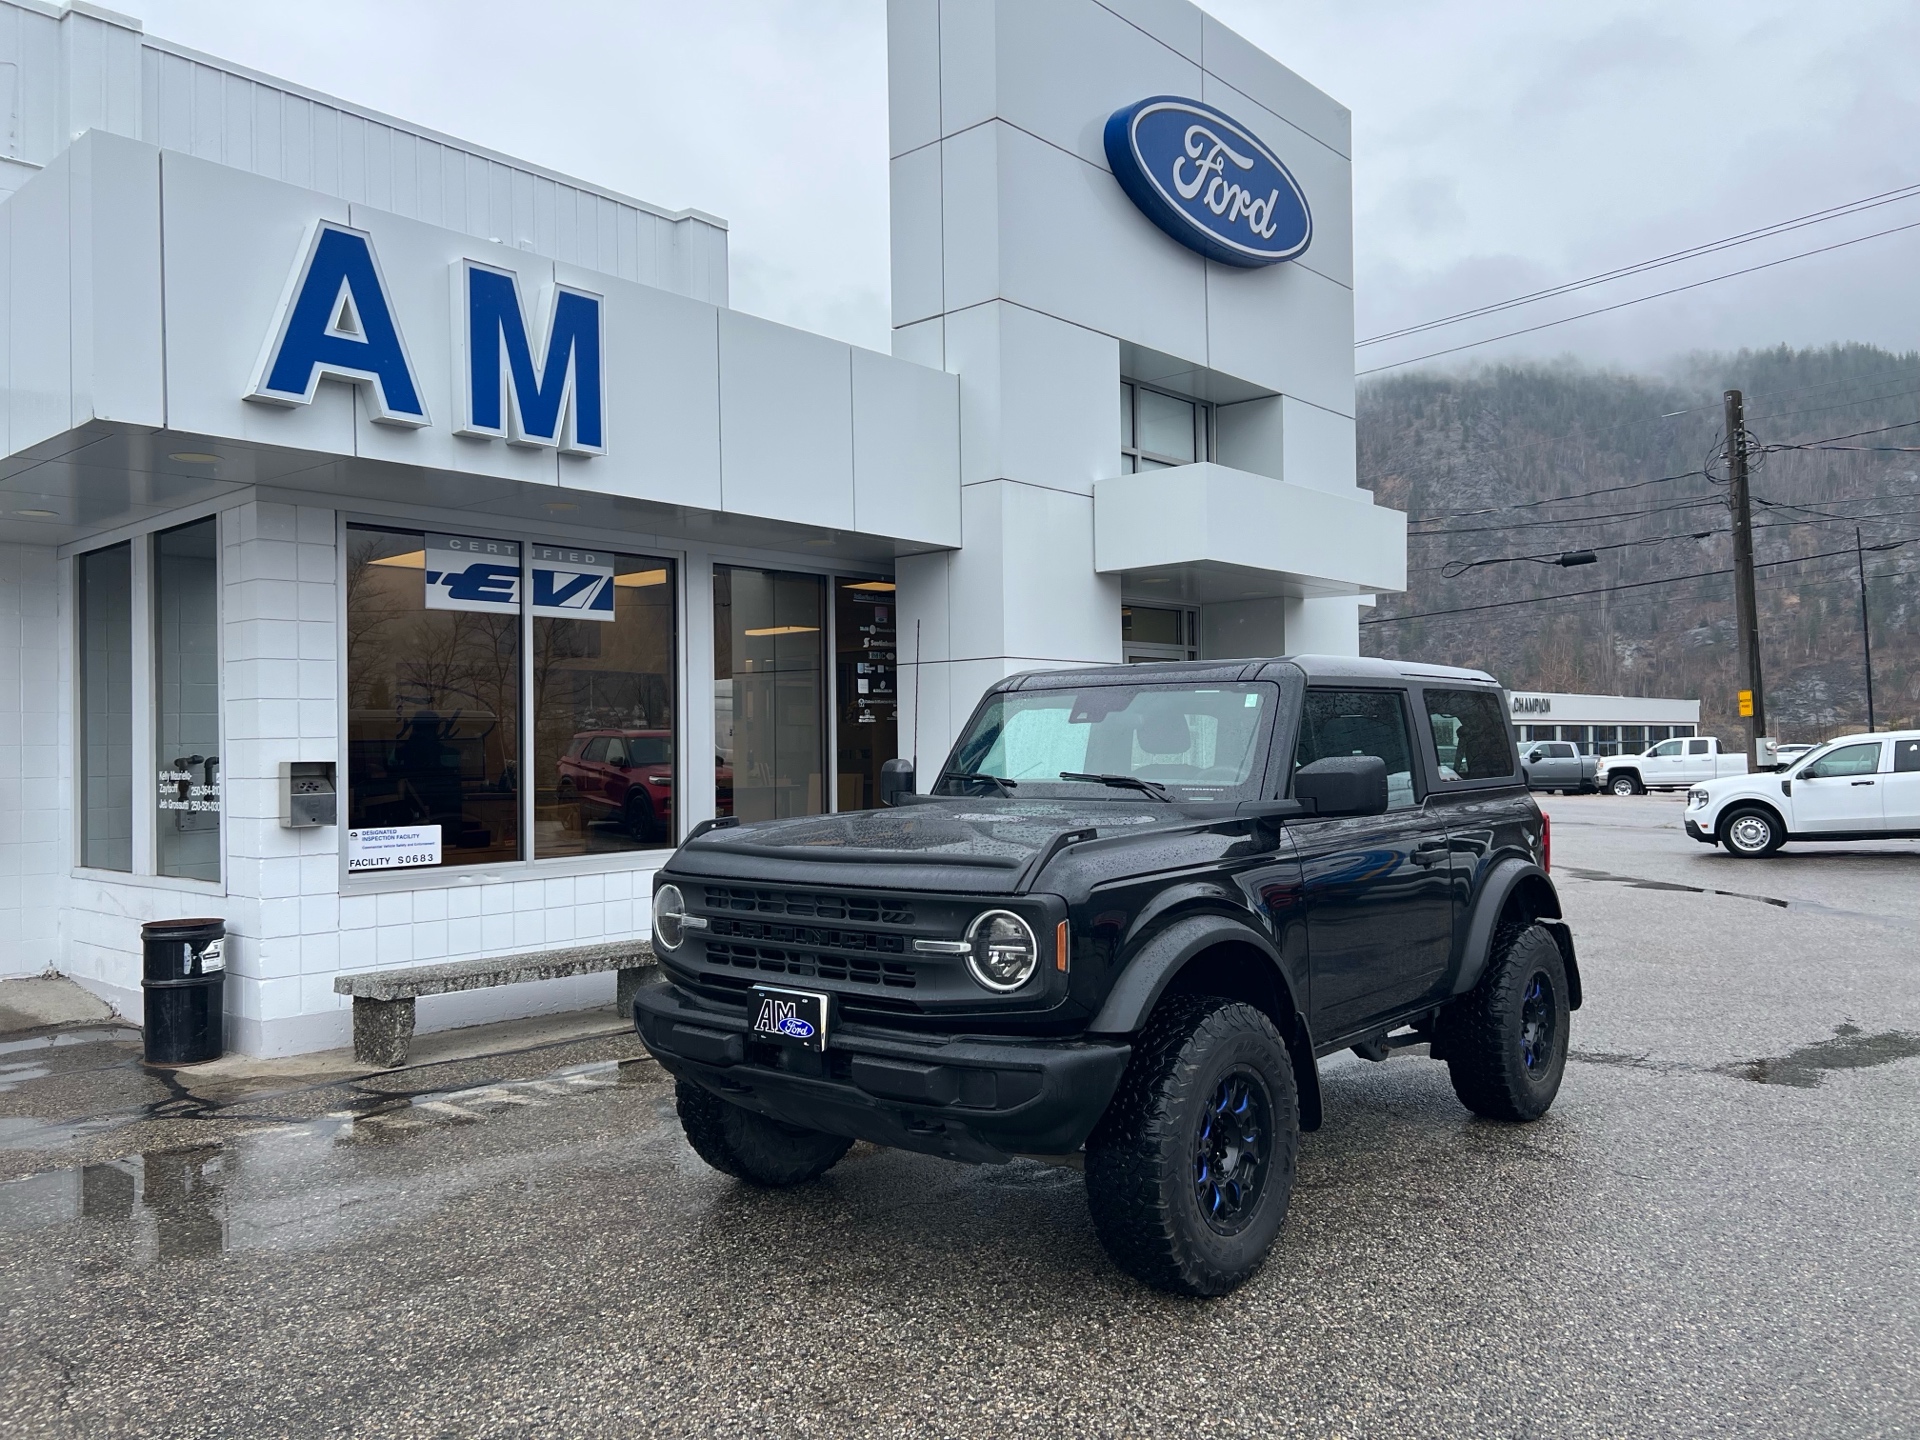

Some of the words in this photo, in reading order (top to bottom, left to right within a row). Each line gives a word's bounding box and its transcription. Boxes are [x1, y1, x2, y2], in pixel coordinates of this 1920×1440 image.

[1173, 124, 1279, 239] Ford
[243, 218, 608, 458] AM
[449, 539, 596, 564] CERTIFIED
[1512, 697, 1551, 713] CHAMPION
[349, 857, 391, 867] FACILITY
[397, 853, 434, 864] S0683
[710, 918, 904, 954] BRONCO
[754, 999, 796, 1035] AM
[784, 1019, 808, 1036] Ford
